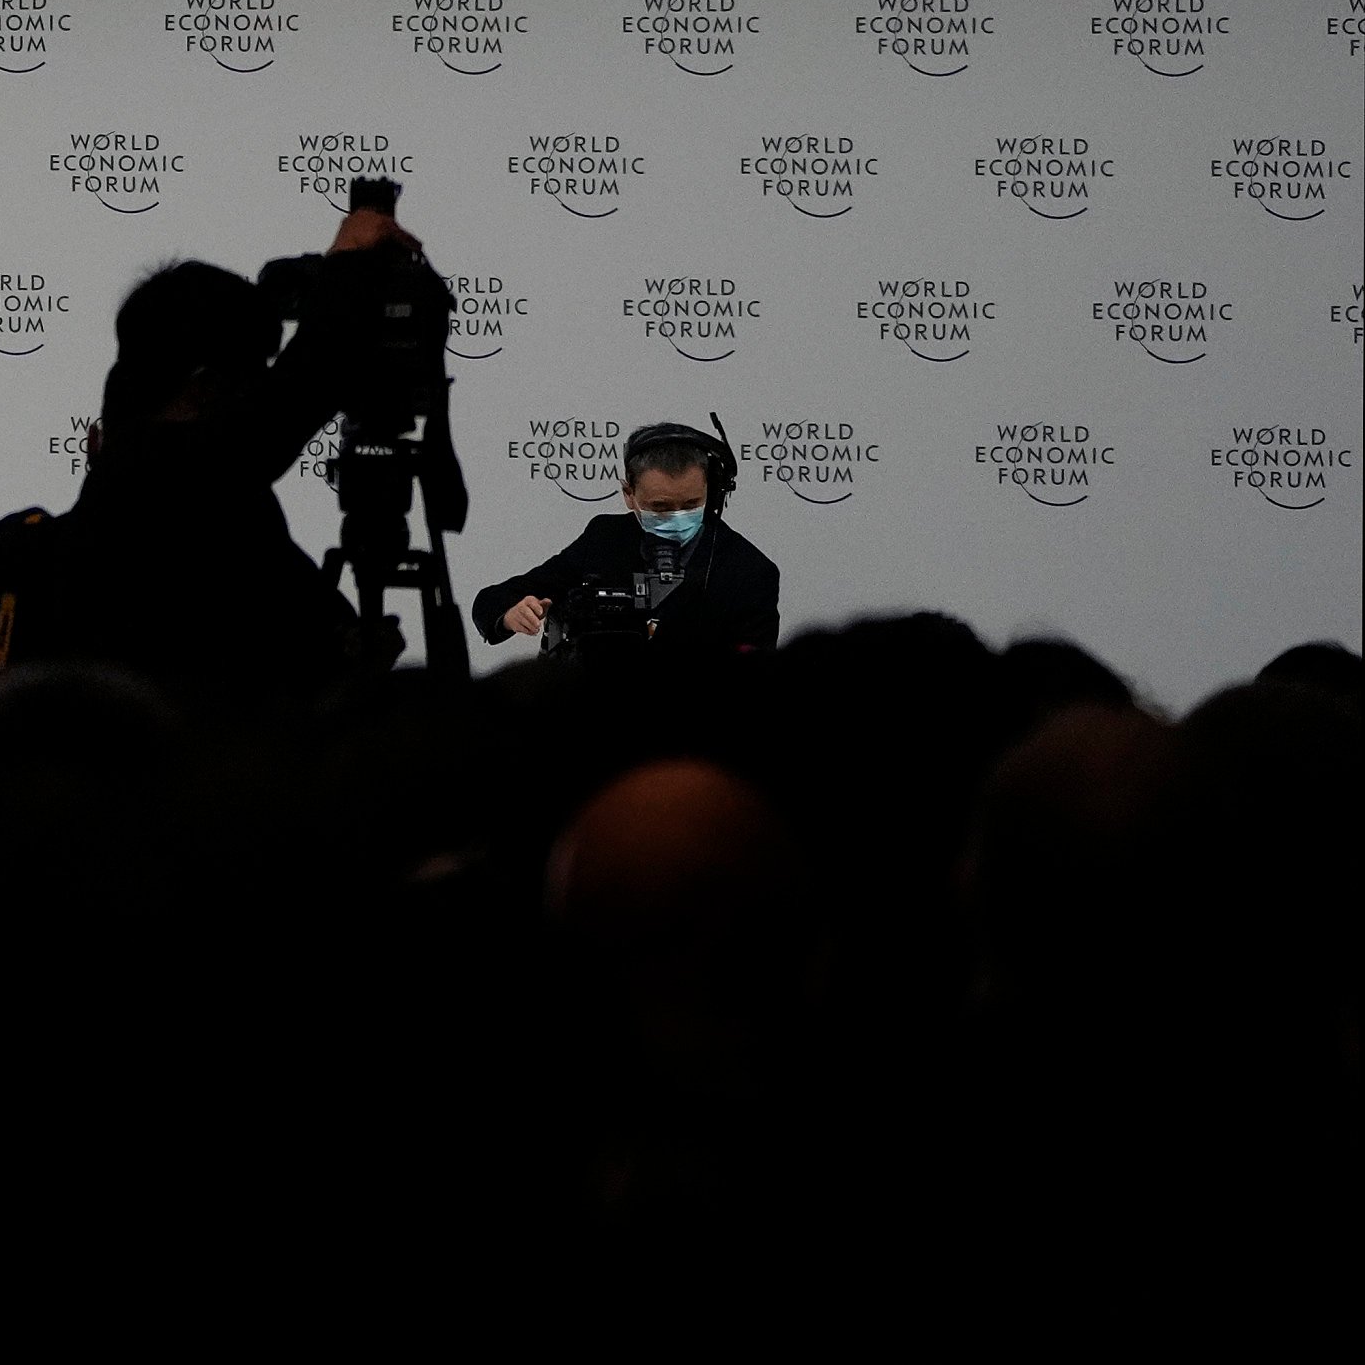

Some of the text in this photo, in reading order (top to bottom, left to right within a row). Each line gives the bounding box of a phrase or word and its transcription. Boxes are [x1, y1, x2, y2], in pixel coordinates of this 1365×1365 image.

[164, 13, 299, 32] ECONOMIC
[392, 14, 528, 33] ECONOMIC
[622, 16, 760, 34] ECONOMIC
[855, 16, 994, 35] ECONOMIC
[1091, 16, 1230, 35] ECONOMIC
[186, 35, 275, 53] FORUM
[413, 36, 503, 54] FORUM
[644, 37, 735, 55] FORUM
[877, 38, 969, 56] FORUM
[1113, 38, 1205, 56] FORUM
[70, 133, 160, 152] WORLD
[529, 135, 620, 154] WORLD
[761, 136, 854, 155] WORLD
[1232, 139, 1326, 157] WORLD
[49, 154, 184, 173] ECONOMIC
[508, 156, 645, 175] ECONOMIC
[740, 157, 878, 176] ECONOMIC
[1210, 160, 1351, 179] ECONOMIC
[71, 176, 160, 194] FORUM
[530, 178, 620, 196] FORUM
[762, 179, 853, 197] FORUM
[1234, 182, 1326, 200] FORUM
[644, 278, 736, 297] WORLD
[878, 280, 971, 298] WORLD
[1114, 281, 1208, 300] WORLD
[622, 299, 761, 318] ECONOMIC
[857, 301, 996, 320] ECONOMIC
[1092, 302, 1233, 321] ECONOMIC
[645, 321, 736, 339] FORUM
[880, 323, 971, 341] FORUM
[1115, 324, 1207, 342] FORUM
[762, 422, 854, 441] WORLD
[996, 425, 1090, 444] WORLD
[1232, 427, 1327, 446] WORLD
[741, 443, 879, 462] ECONOMIC
[975, 446, 1115, 465] ECONOMIC
[1210, 449, 1352, 467] ECONOMIC
[763, 465, 854, 484] FORUM
[998, 468, 1089, 486] FORUM
[1234, 471, 1326, 489] FORUM
